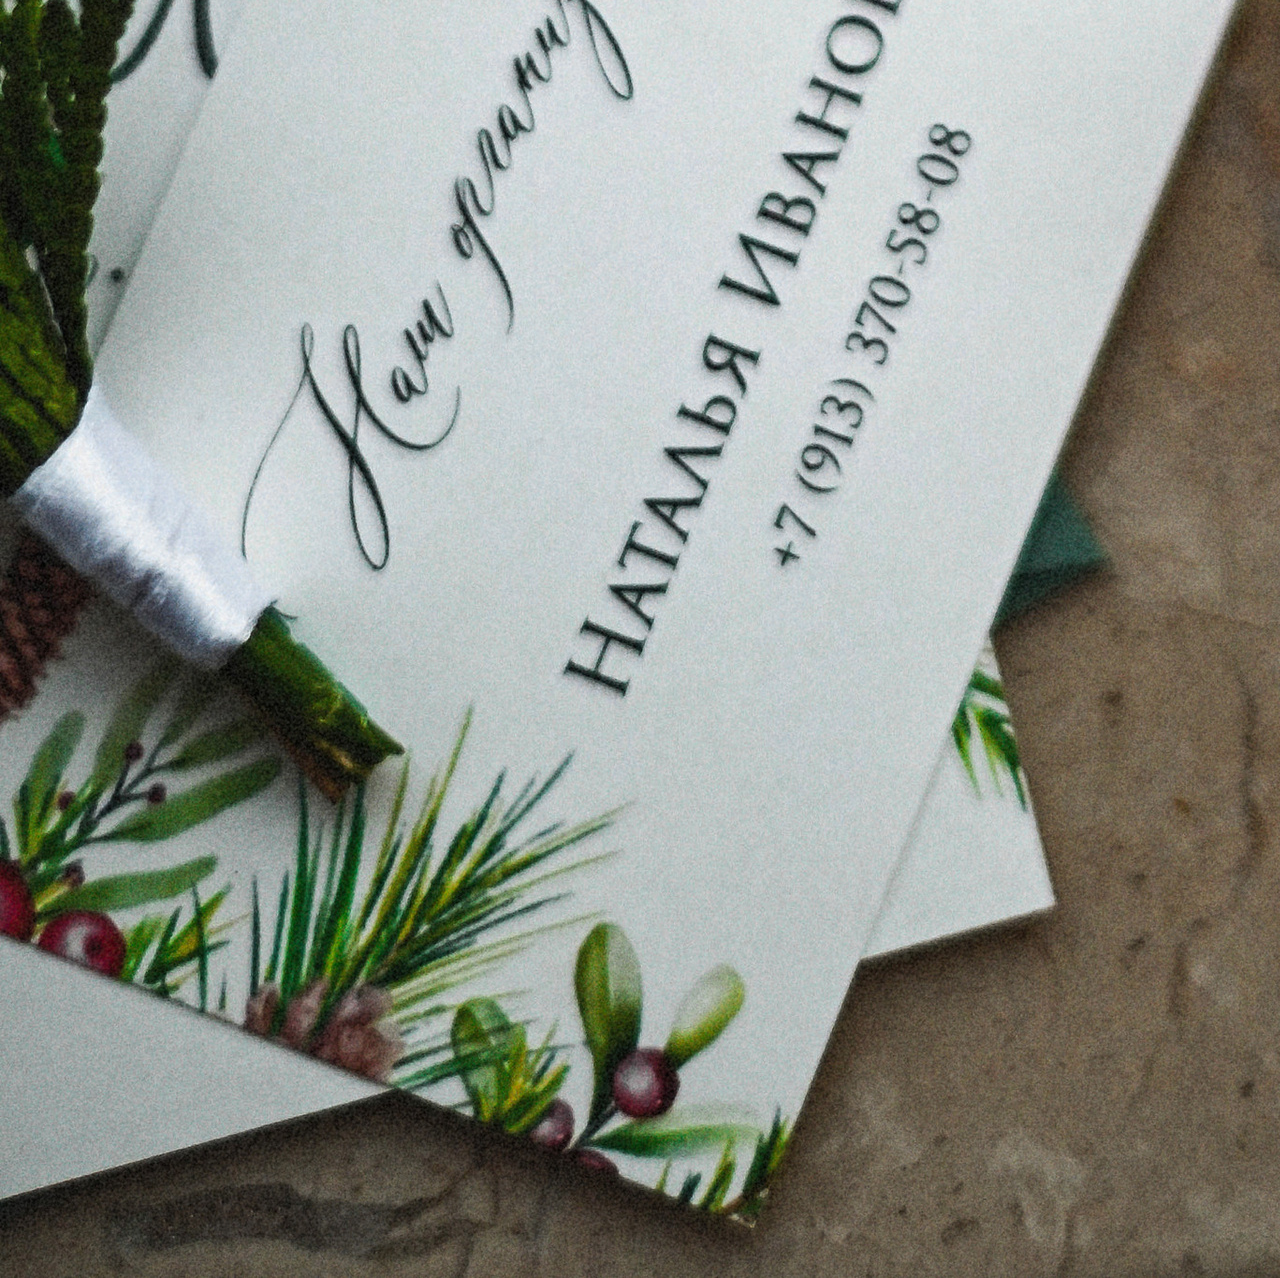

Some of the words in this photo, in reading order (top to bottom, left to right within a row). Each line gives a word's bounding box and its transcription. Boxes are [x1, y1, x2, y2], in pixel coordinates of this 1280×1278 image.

[240, 284, 461, 570] Наш
[562, 333, 761, 698] НАТАЛЬЯ
[774, 504, 820, 569] +7
[798, 377, 874, 494] (913)
[844, 122, 973, 367] 370-58-08
